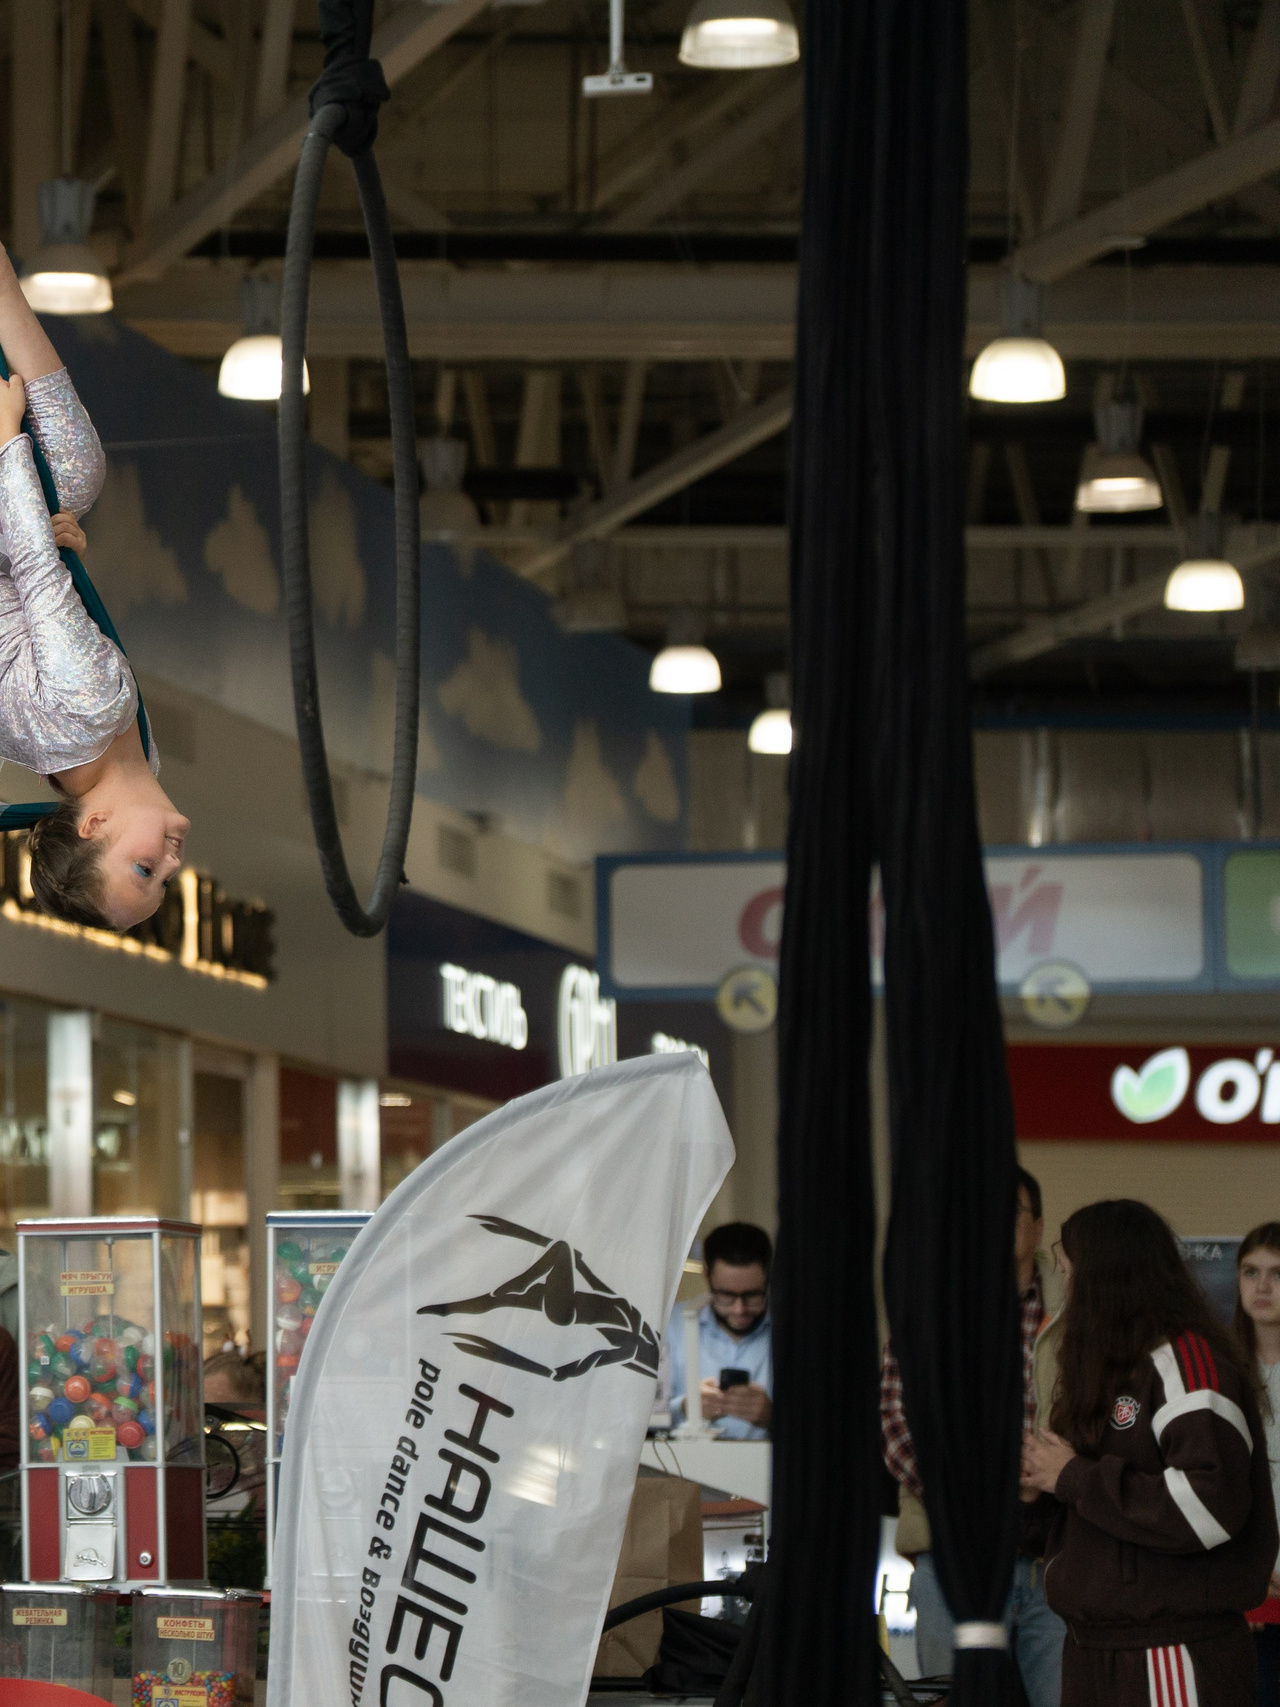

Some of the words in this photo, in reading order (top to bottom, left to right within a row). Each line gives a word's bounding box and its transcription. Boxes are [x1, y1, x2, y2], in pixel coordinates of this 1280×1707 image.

[61, 1273, 78, 1281] МЯЧ
[68, 1285, 107, 1294] ИГРУШКА
[405, 1358, 441, 1429] pole
[376, 1436, 419, 1530] dance
[368, 1537, 392, 1560] &
[15, 1609, 62, 1617] ЖЕВАТЕЛЬНАЯ
[26, 1617, 54, 1625] РЕЗИНКА
[164, 1619, 206, 1628] КОНФЕТЫ
[159, 1629, 195, 1638] НЕСКОЛЬКО
